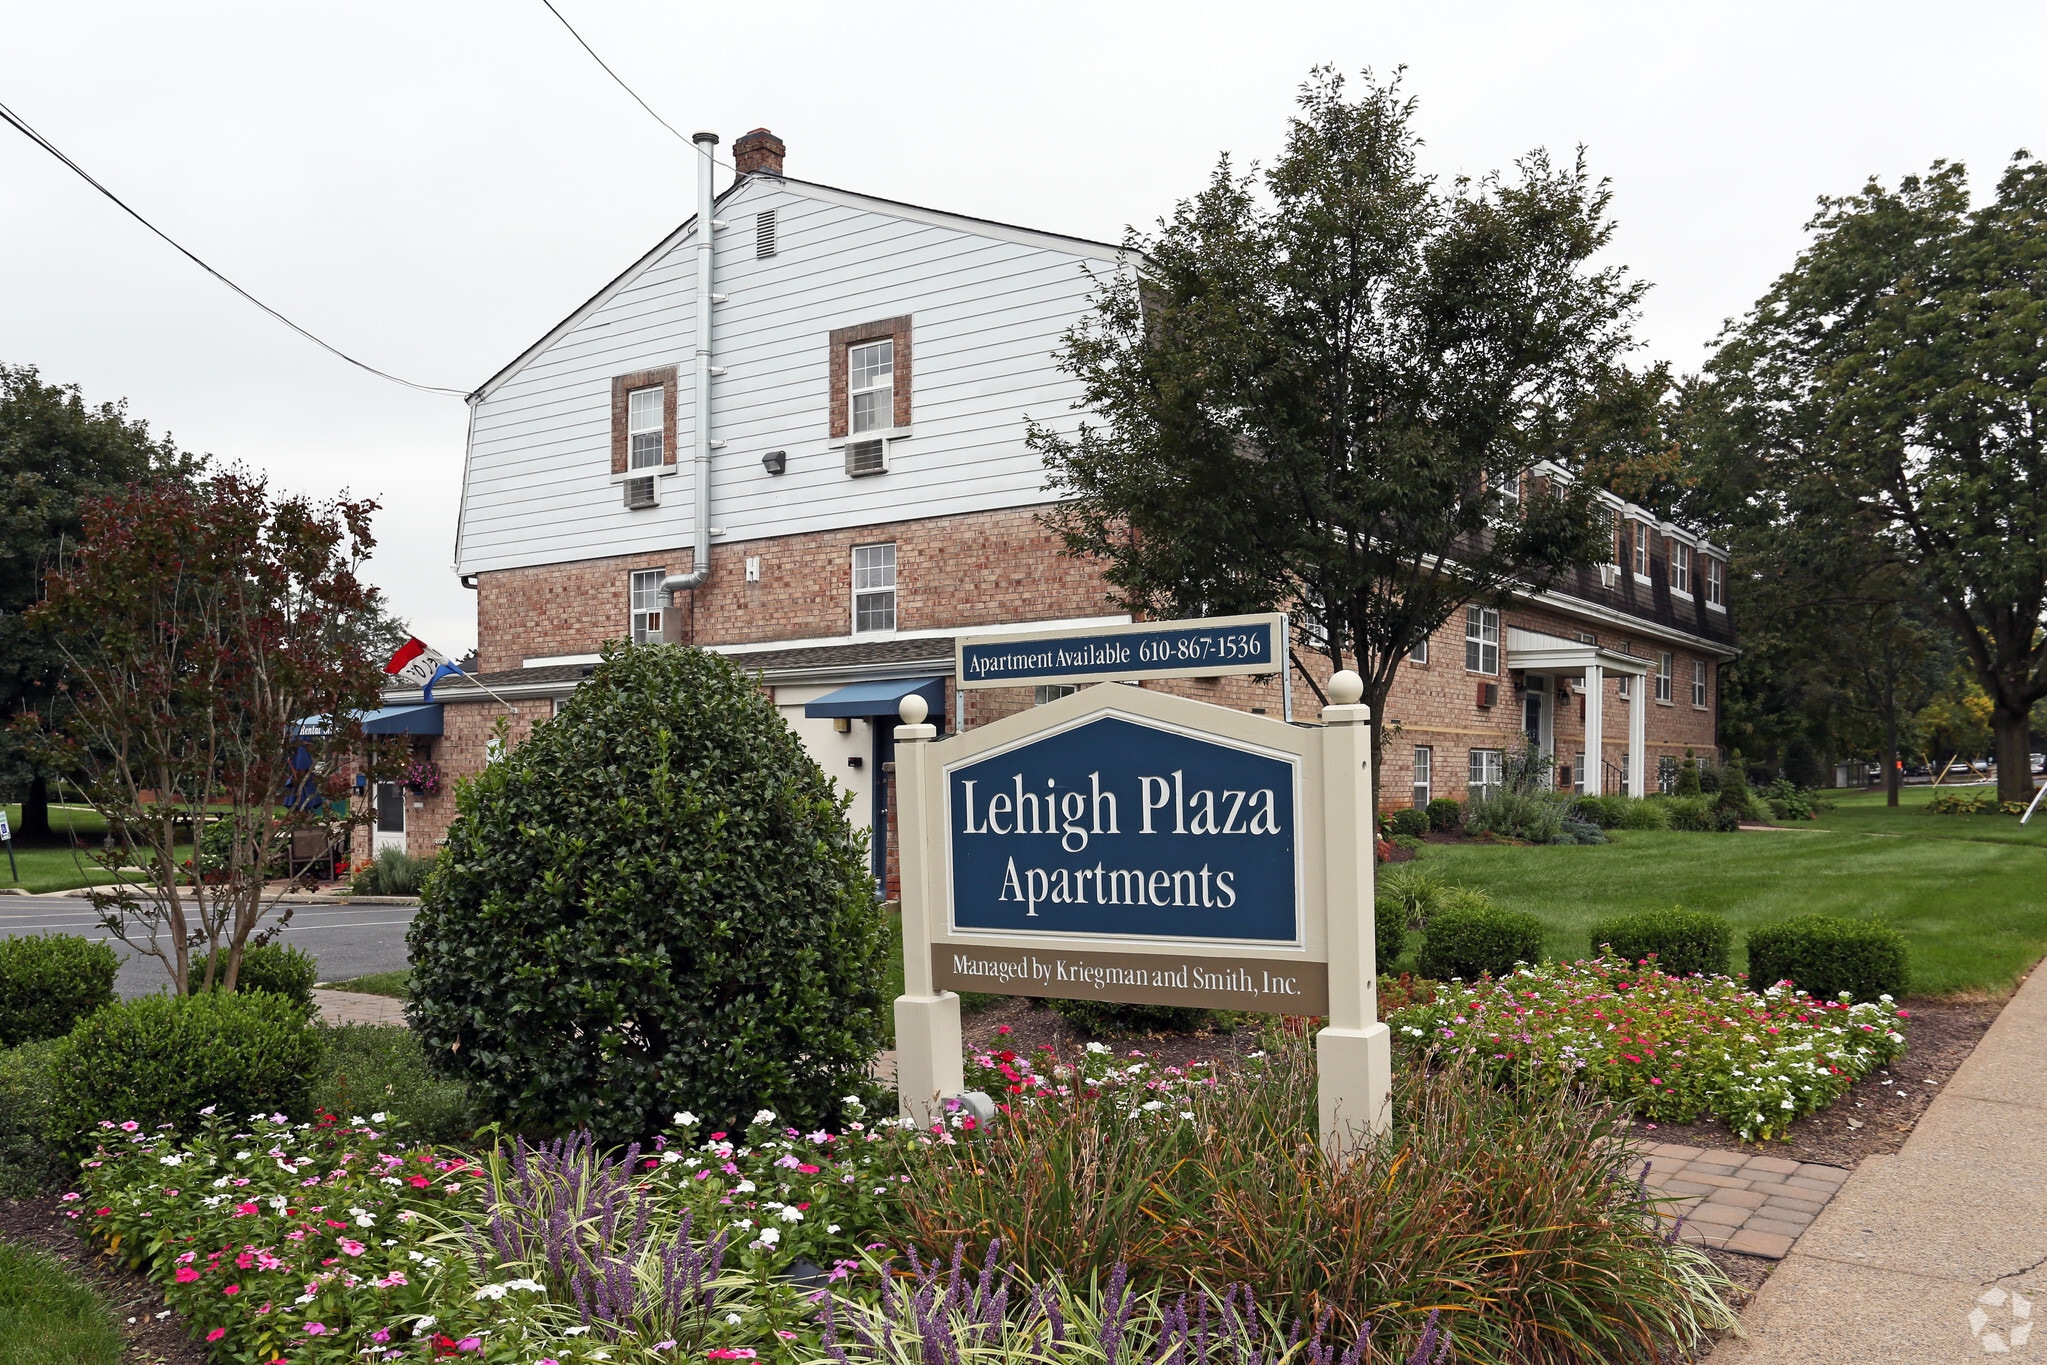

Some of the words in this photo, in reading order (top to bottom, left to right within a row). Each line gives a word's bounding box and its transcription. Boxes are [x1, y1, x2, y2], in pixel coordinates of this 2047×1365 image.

[969, 653, 1053, 678] Apartment
[1056, 643, 1130, 667] Available
[1138, 631, 1261, 663] 610-867-1536
[962, 768, 1121, 853] Lehigh
[1138, 769, 1281, 836] Plaza
[998, 855, 1237, 917] Apartments
[952, 953, 1028, 983] Managed
[1032, 955, 1052, 987] by
[1056, 960, 1149, 990] Kriegman
[1152, 964, 1188, 990] and
[1193, 967, 1259, 996] Smith,
[1262, 971, 1302, 997] Inc.
